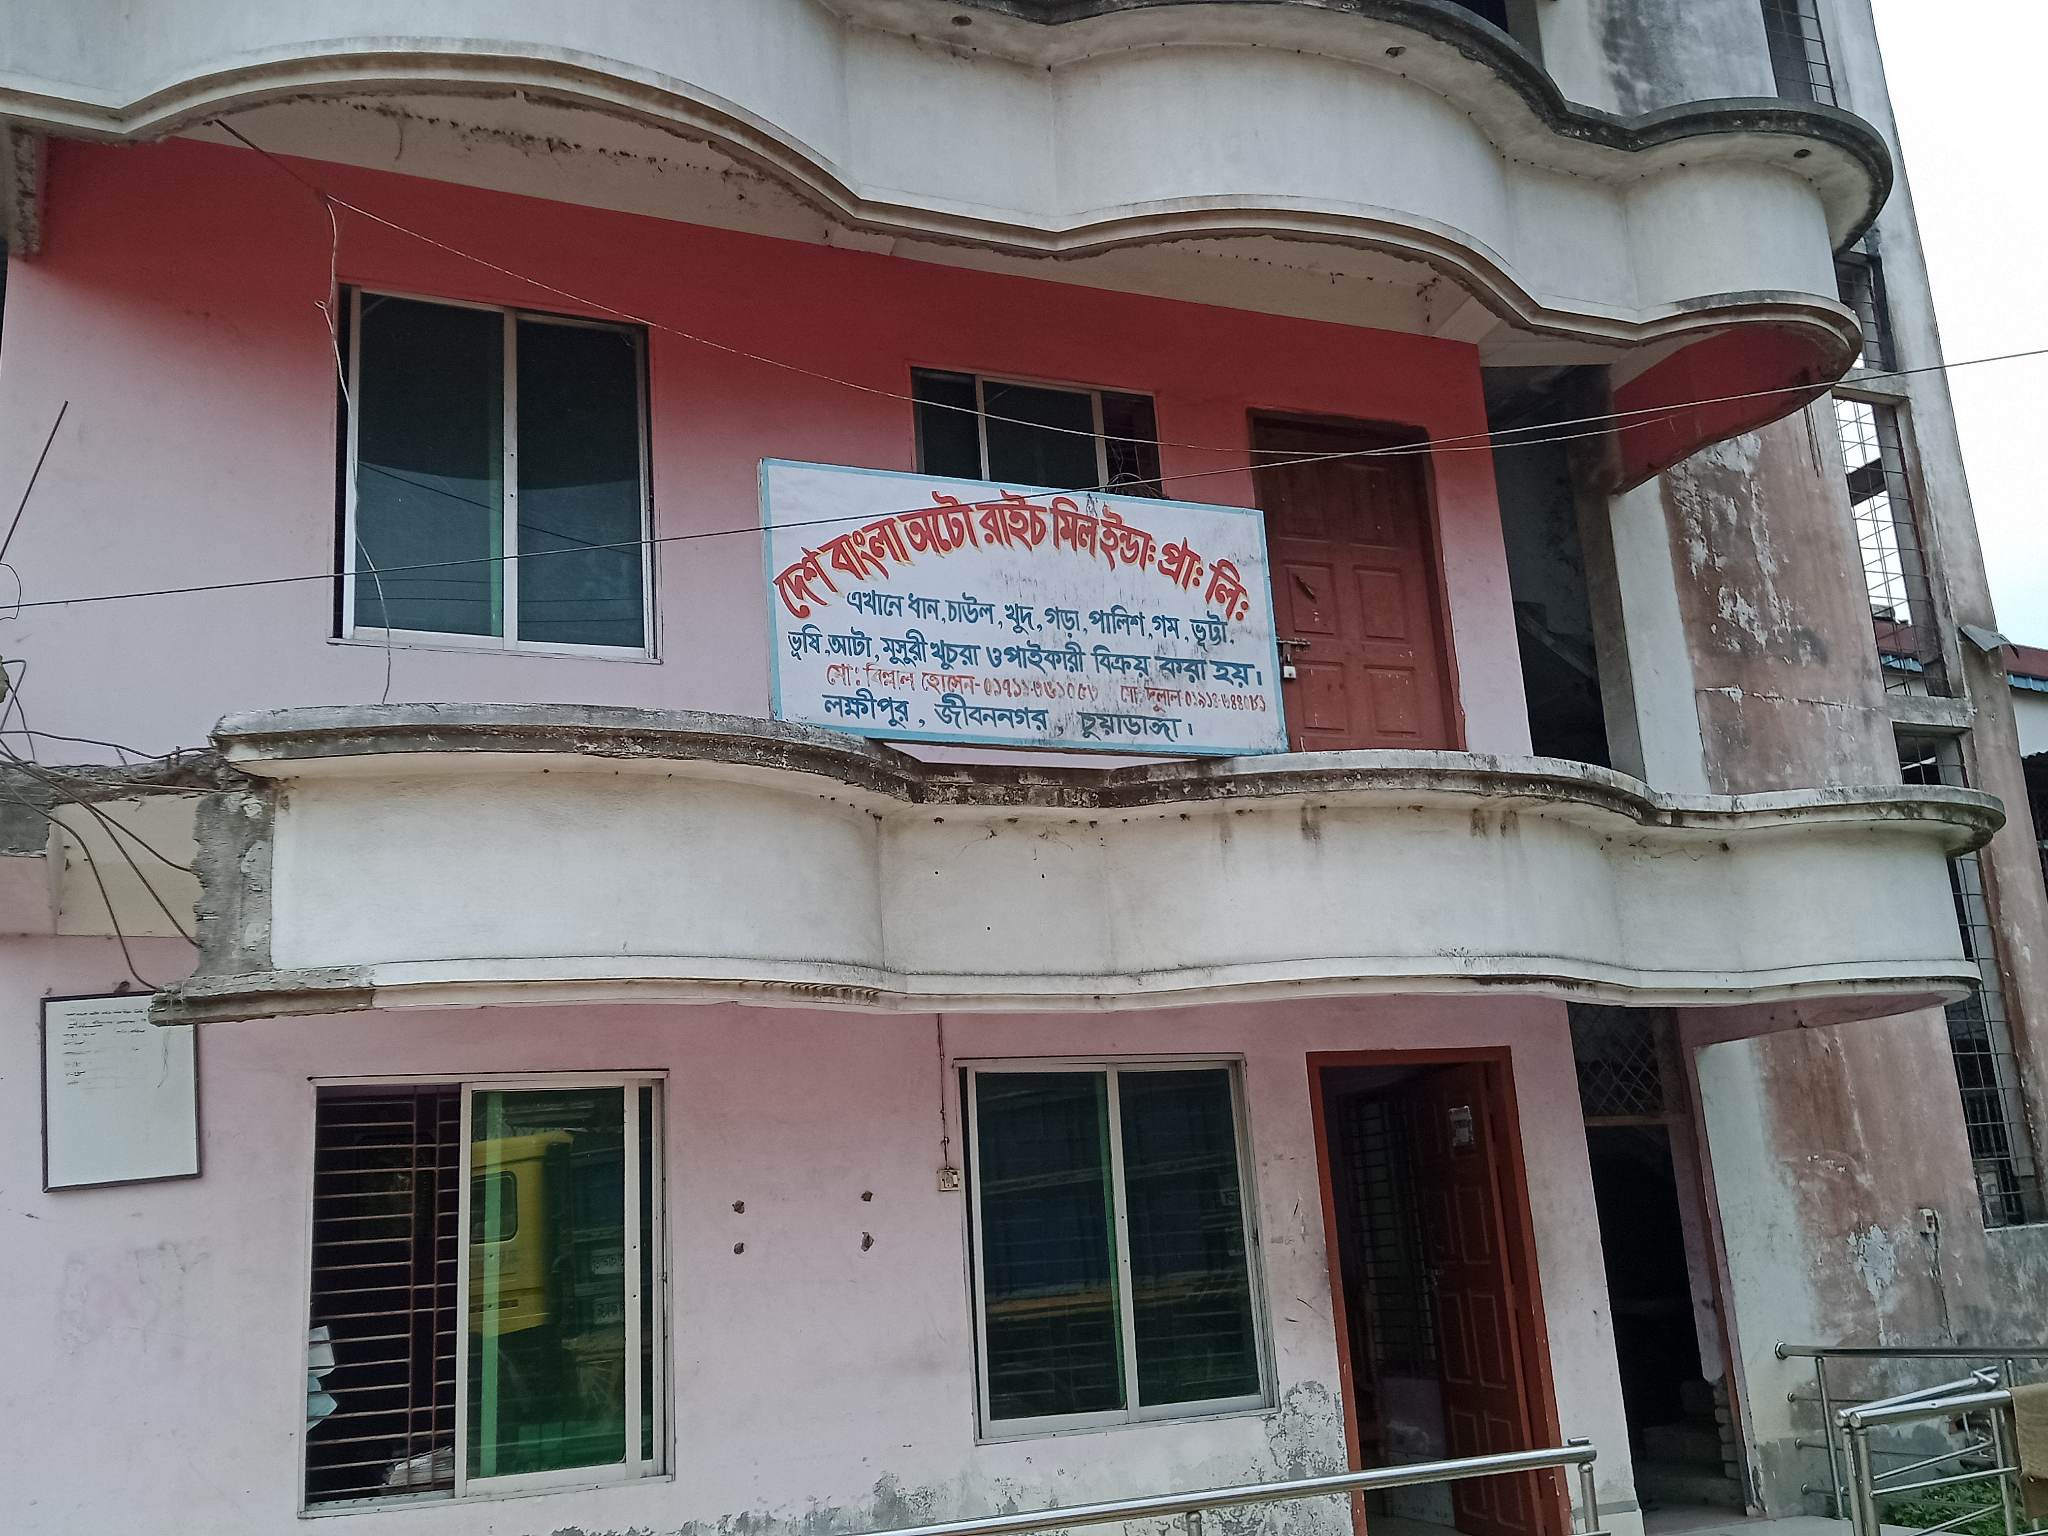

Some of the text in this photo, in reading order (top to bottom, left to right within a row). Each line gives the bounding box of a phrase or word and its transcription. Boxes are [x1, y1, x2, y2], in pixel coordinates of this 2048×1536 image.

[773, 547, 838, 618] দেশ
[817, 517, 911, 580] বাংলা
[897, 491, 979, 554] অটো
[976, 489, 1047, 551] রাইচ
[1050, 497, 1100, 557] মিল
[847, 590, 904, 616] এখানে
[1003, 640, 1086, 674] পাইকারী
[1154, 656, 1207, 683] করা
